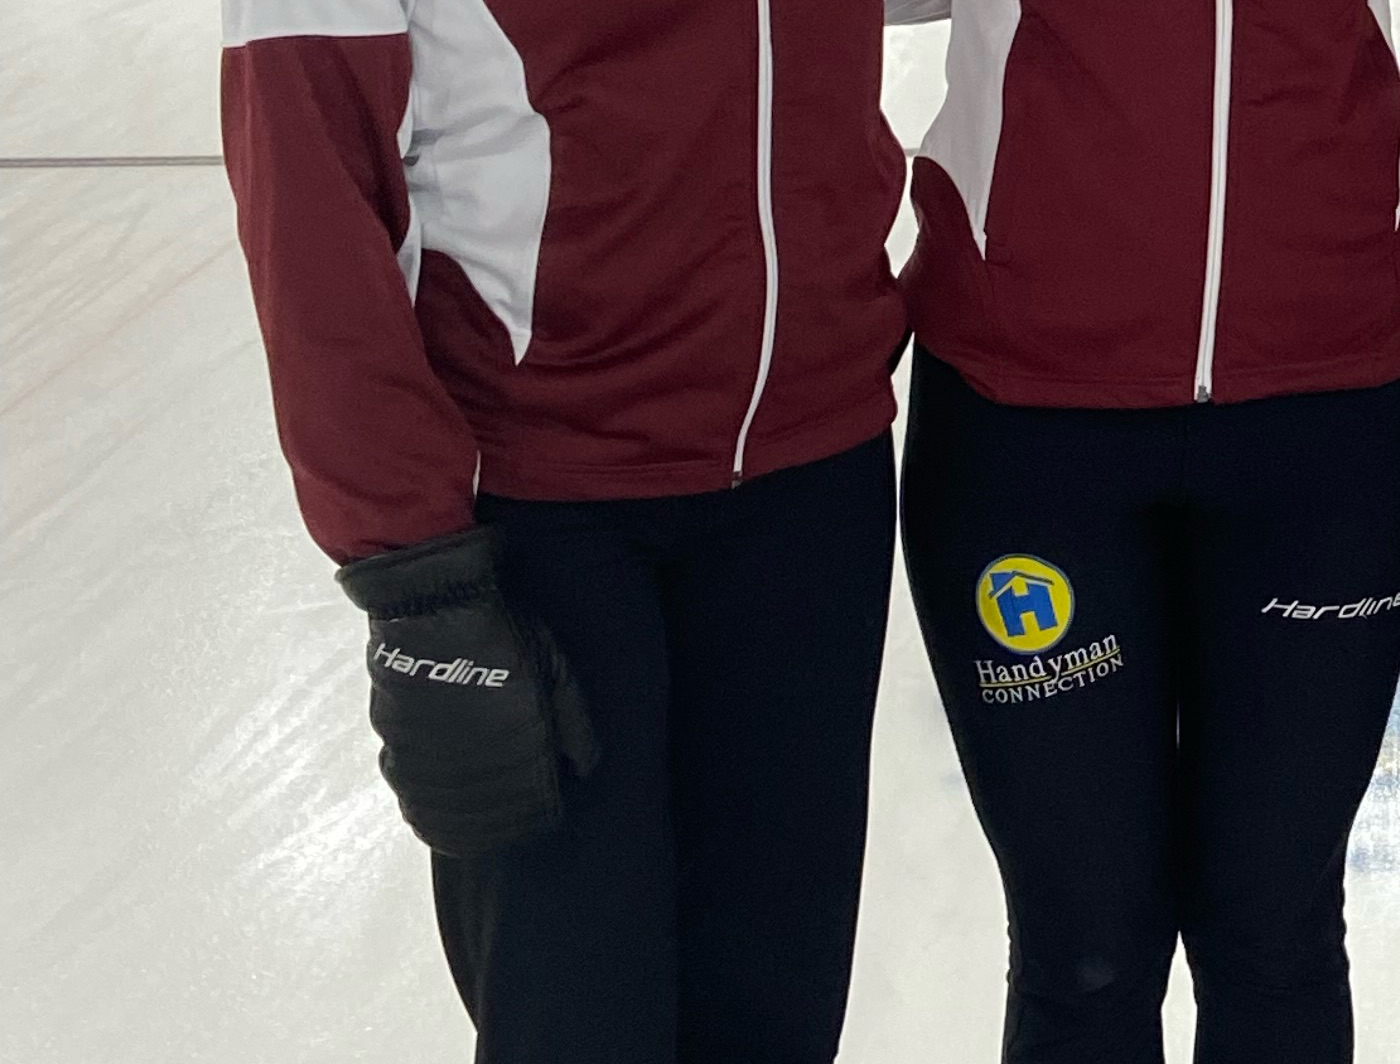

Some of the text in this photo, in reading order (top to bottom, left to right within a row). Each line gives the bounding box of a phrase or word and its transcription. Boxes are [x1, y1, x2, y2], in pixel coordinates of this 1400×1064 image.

[373, 642, 510, 688] Hardline
[975, 634, 1121, 684] Handyman
[982, 653, 1124, 704] CONNECTION
